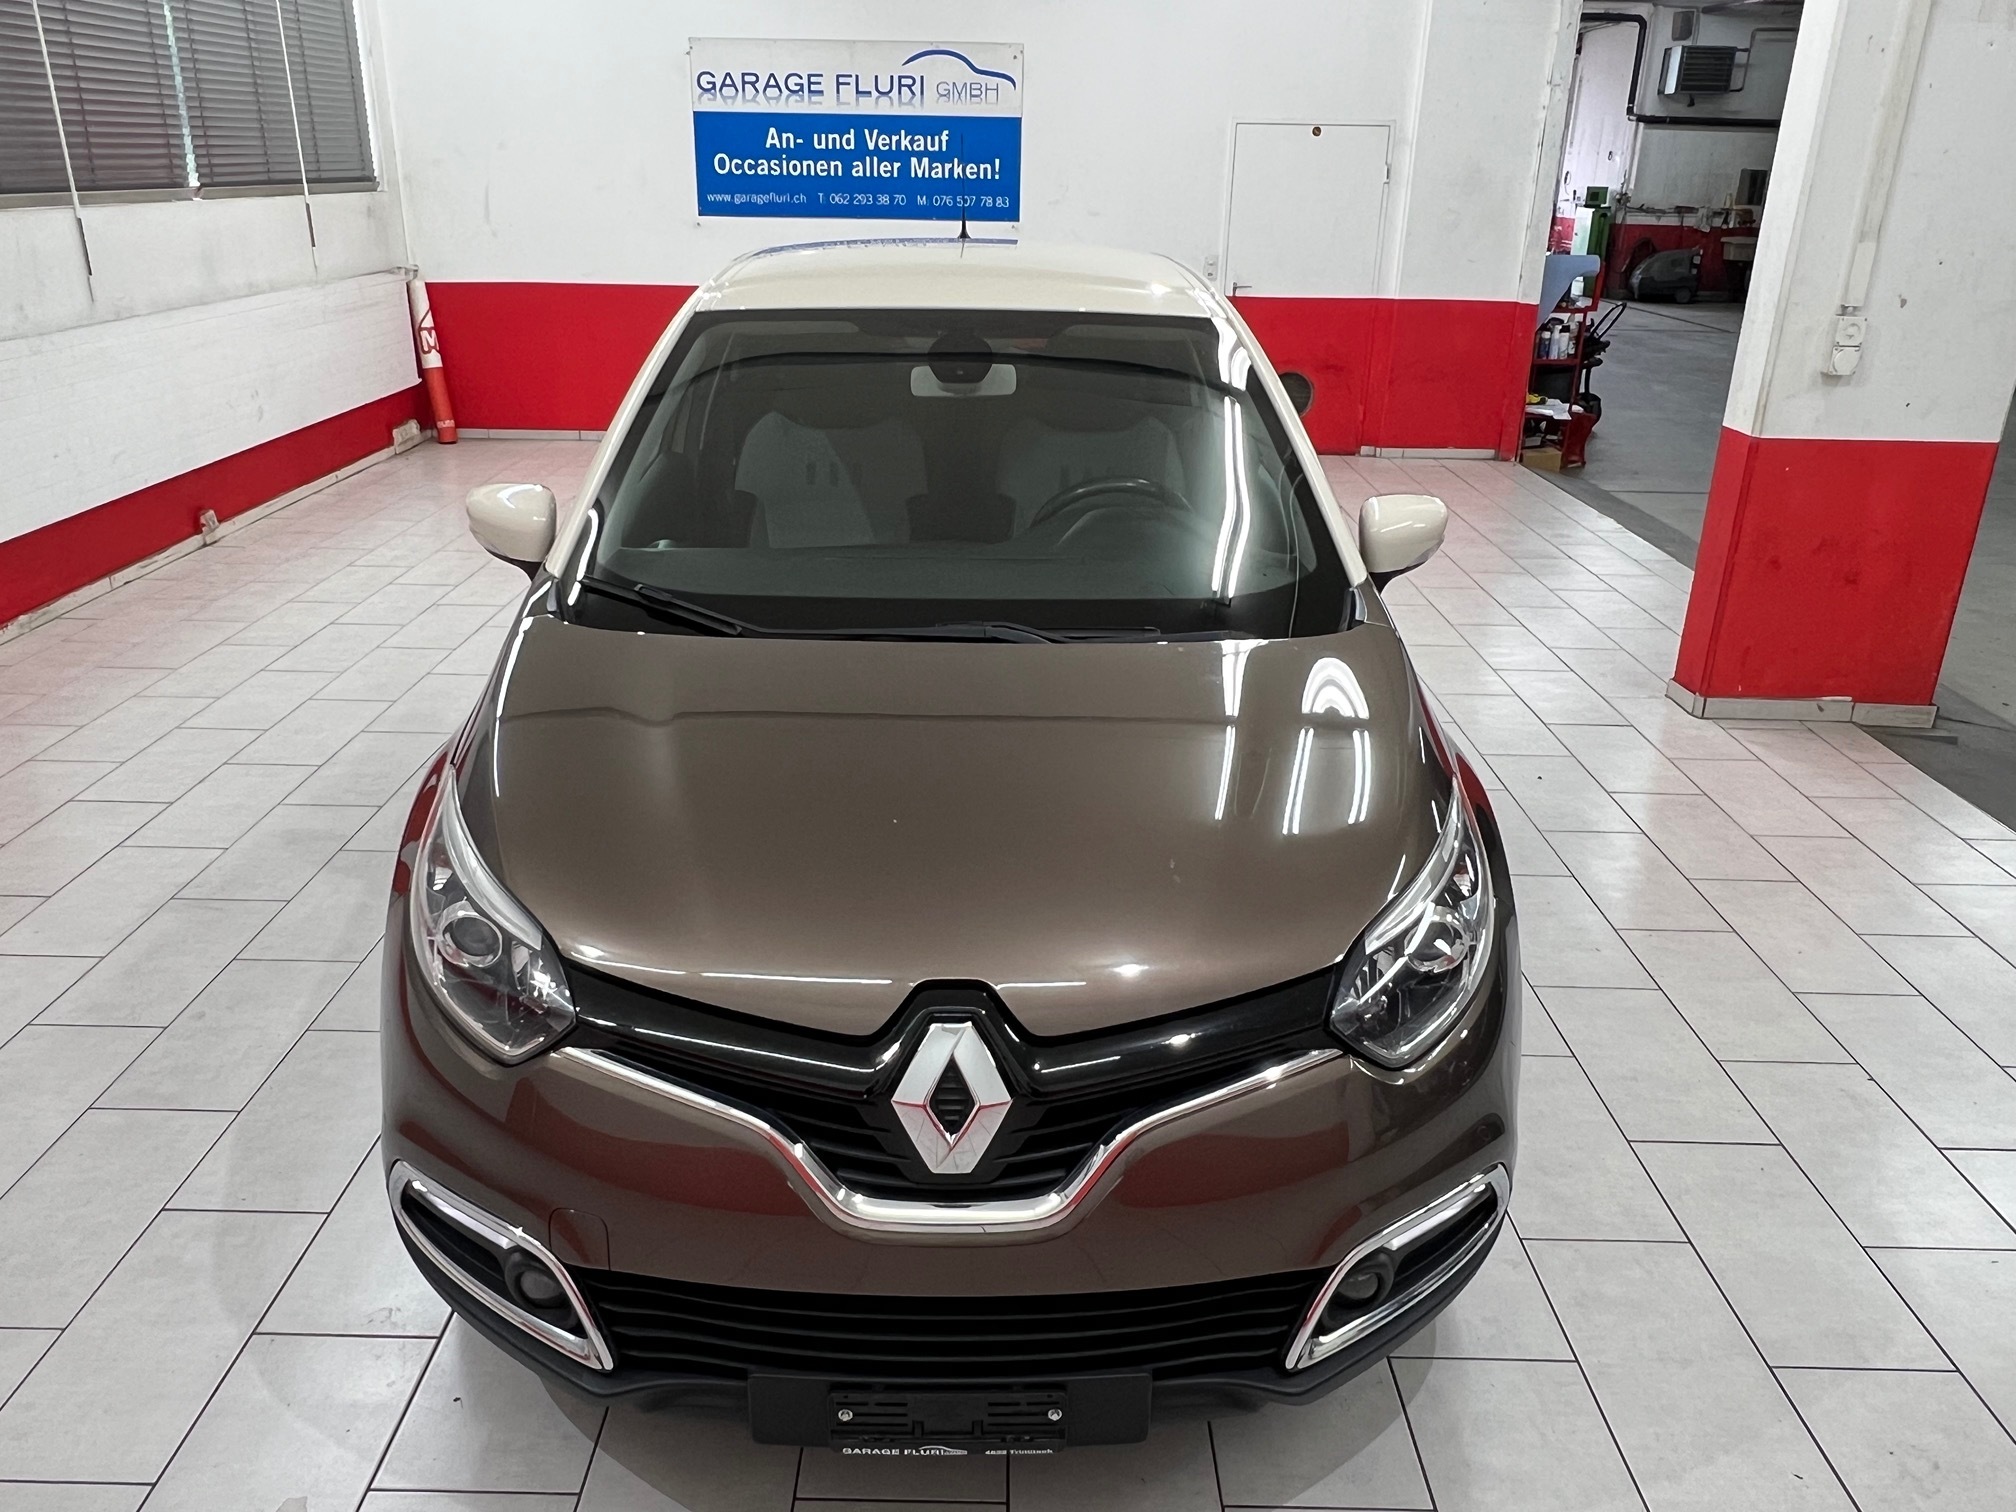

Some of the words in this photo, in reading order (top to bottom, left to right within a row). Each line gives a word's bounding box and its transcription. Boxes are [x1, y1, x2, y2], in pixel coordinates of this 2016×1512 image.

[696, 71, 824, 95] GARAGE
[836, 74, 924, 97] FLURI
[936, 81, 998, 100] GMBH
[765, 127, 804, 149] An-
[813, 129, 855, 150] und
[864, 128, 949, 152] Verkauf
[713, 153, 842, 176] Occasionen
[851, 156, 900, 177] aller
[910, 157, 1000, 180] Marken!
[706, 192, 807, 205] www.garagefluri.ch
[829, 193, 850, 205] 062
[853, 194, 873, 205] 293
[876, 194, 890, 205] 38
[893, 194, 907, 206] 70
[932, 195, 953, 207] 076
[979, 196, 993, 208] 78
[995, 196, 1010, 209] 83
[842, 1447, 900, 1456] GARAGE
